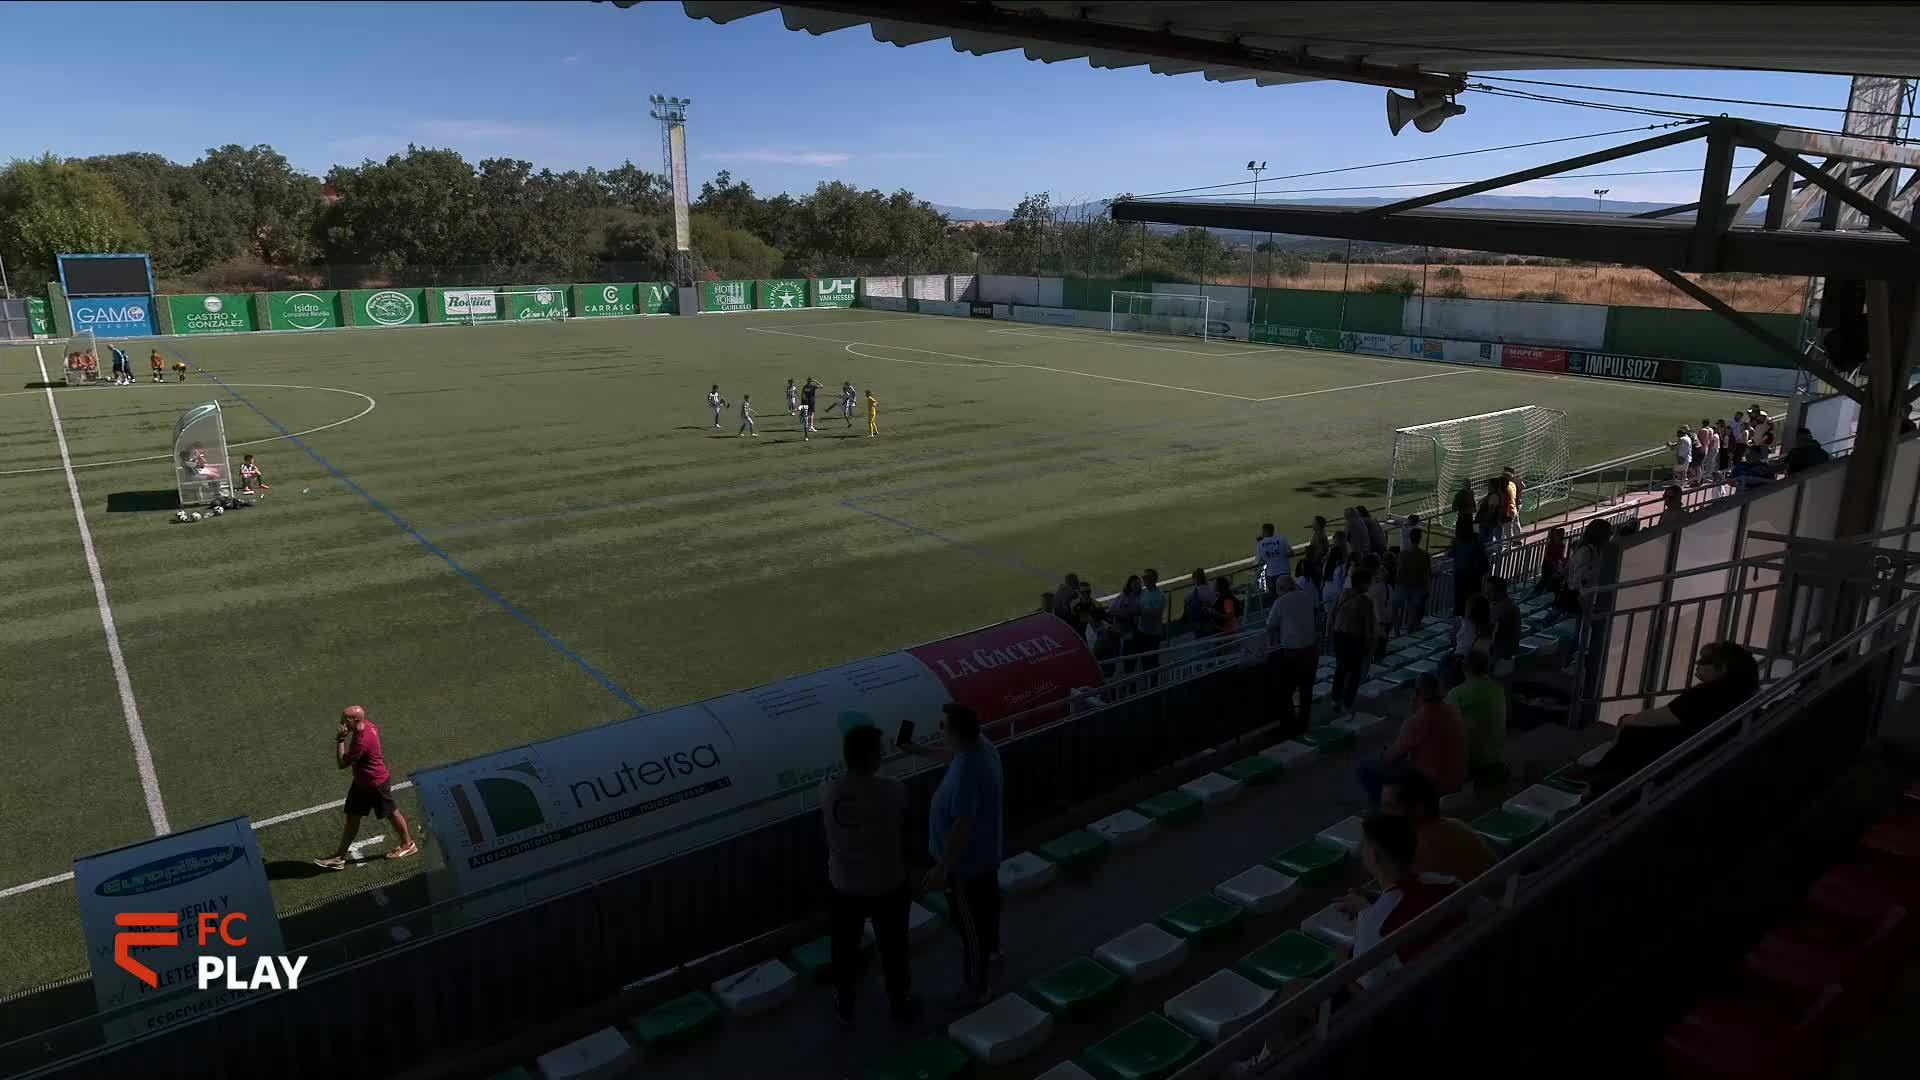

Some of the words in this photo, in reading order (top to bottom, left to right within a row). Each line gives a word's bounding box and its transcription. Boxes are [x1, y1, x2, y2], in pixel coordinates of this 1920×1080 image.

[818, 294, 832, 302] VAN
[294, 304, 319, 313] Isidro
[584, 303, 638, 312] CARRASCO
[76, 306, 145, 323] GAMO
[186, 312, 229, 321] CASTRO
[1584, 353, 1660, 380] IMPULSO27
[568, 743, 721, 809] nutersa
